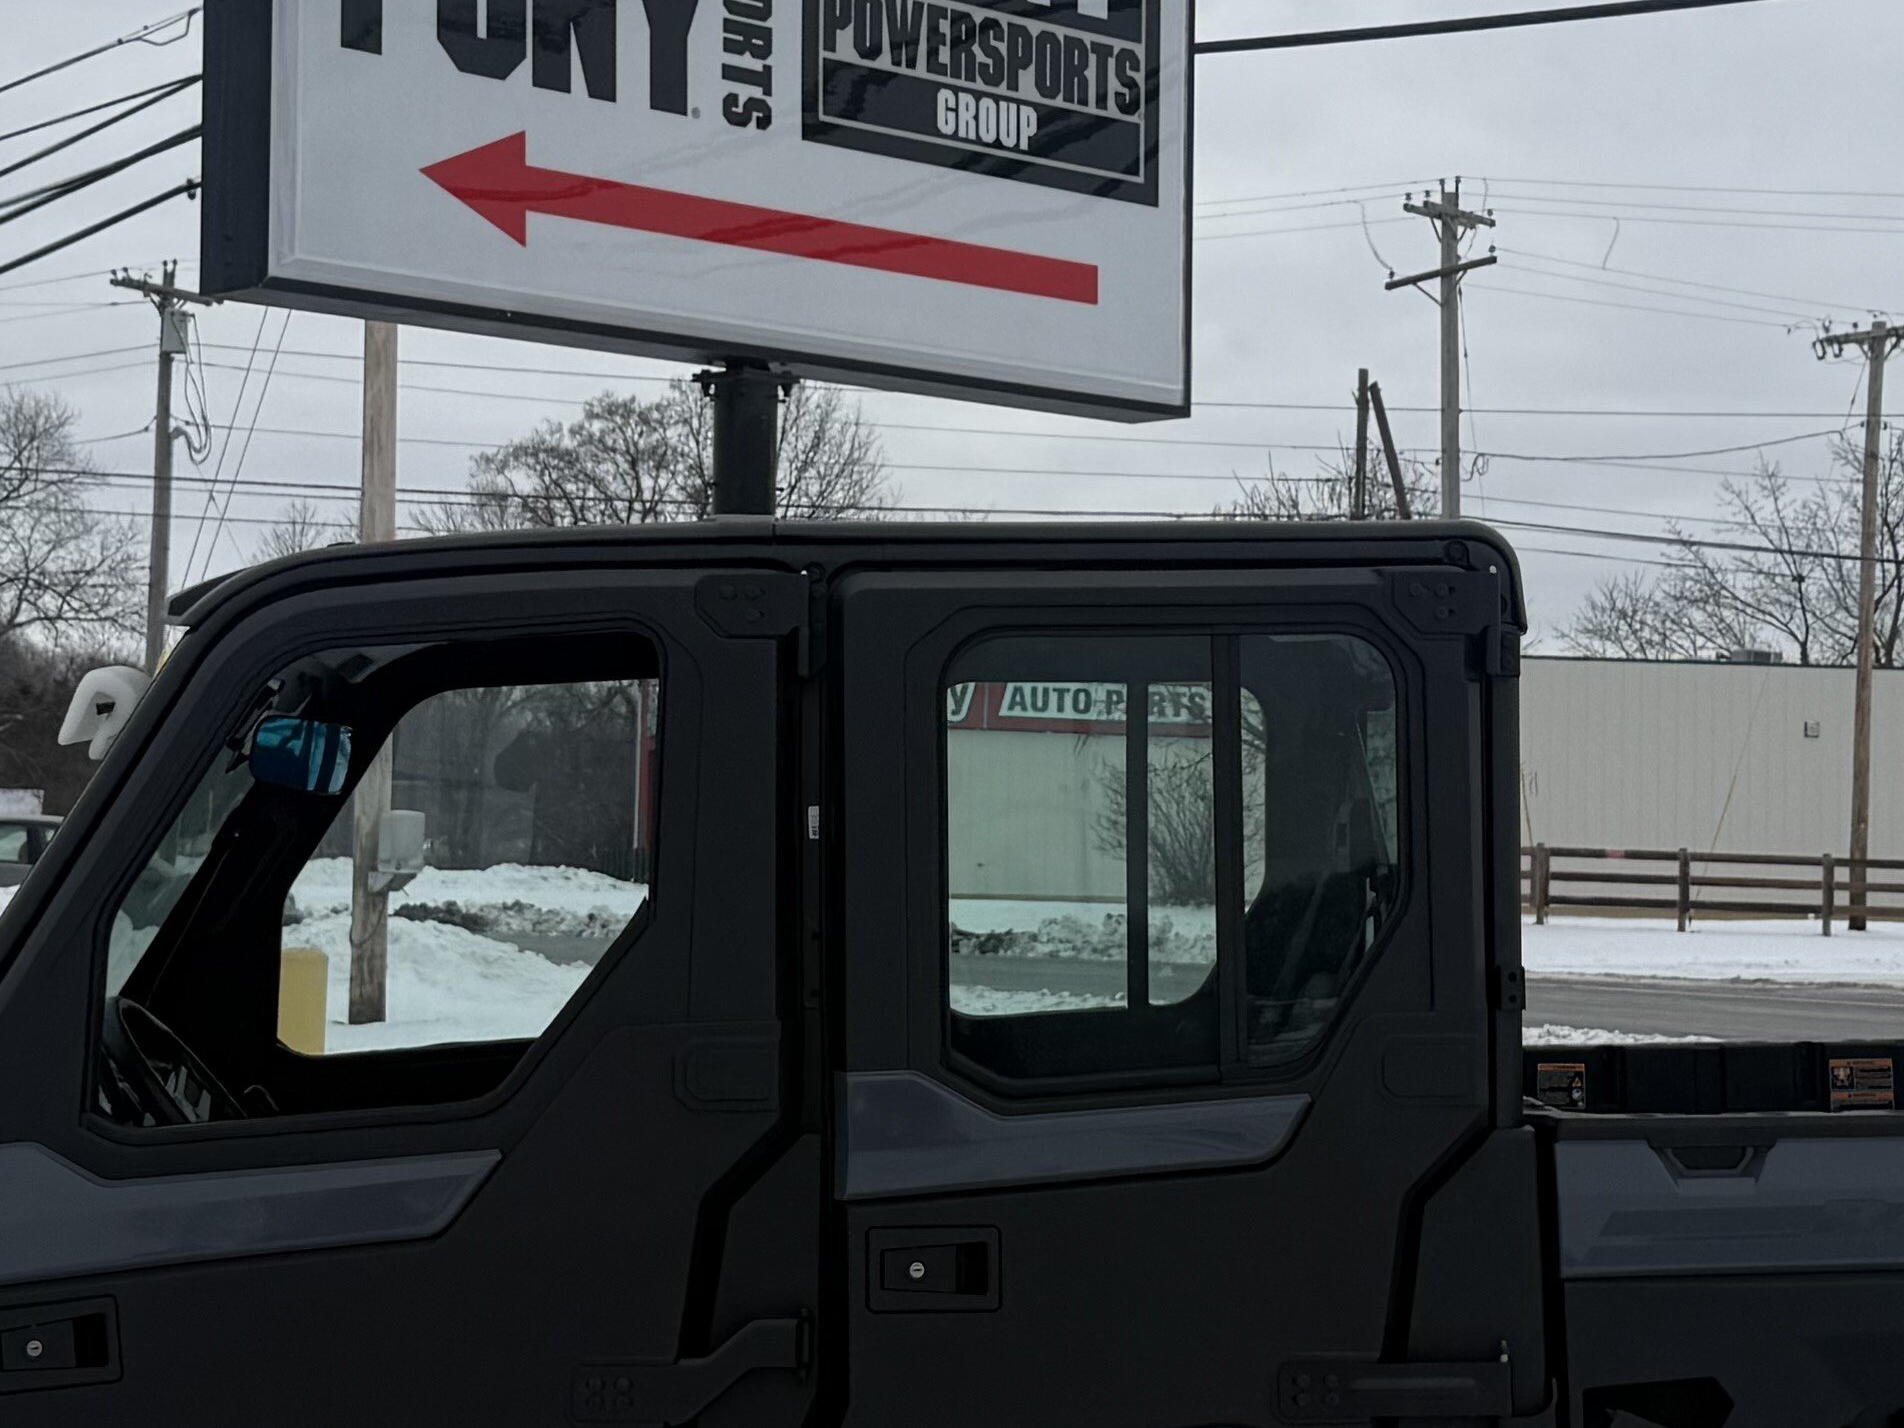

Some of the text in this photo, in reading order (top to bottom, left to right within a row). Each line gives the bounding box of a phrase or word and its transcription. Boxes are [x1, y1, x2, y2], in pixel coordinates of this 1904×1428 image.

[936, 88, 1039, 152] GROUP
[1007, 685, 1207, 718] AUTO PRTS
